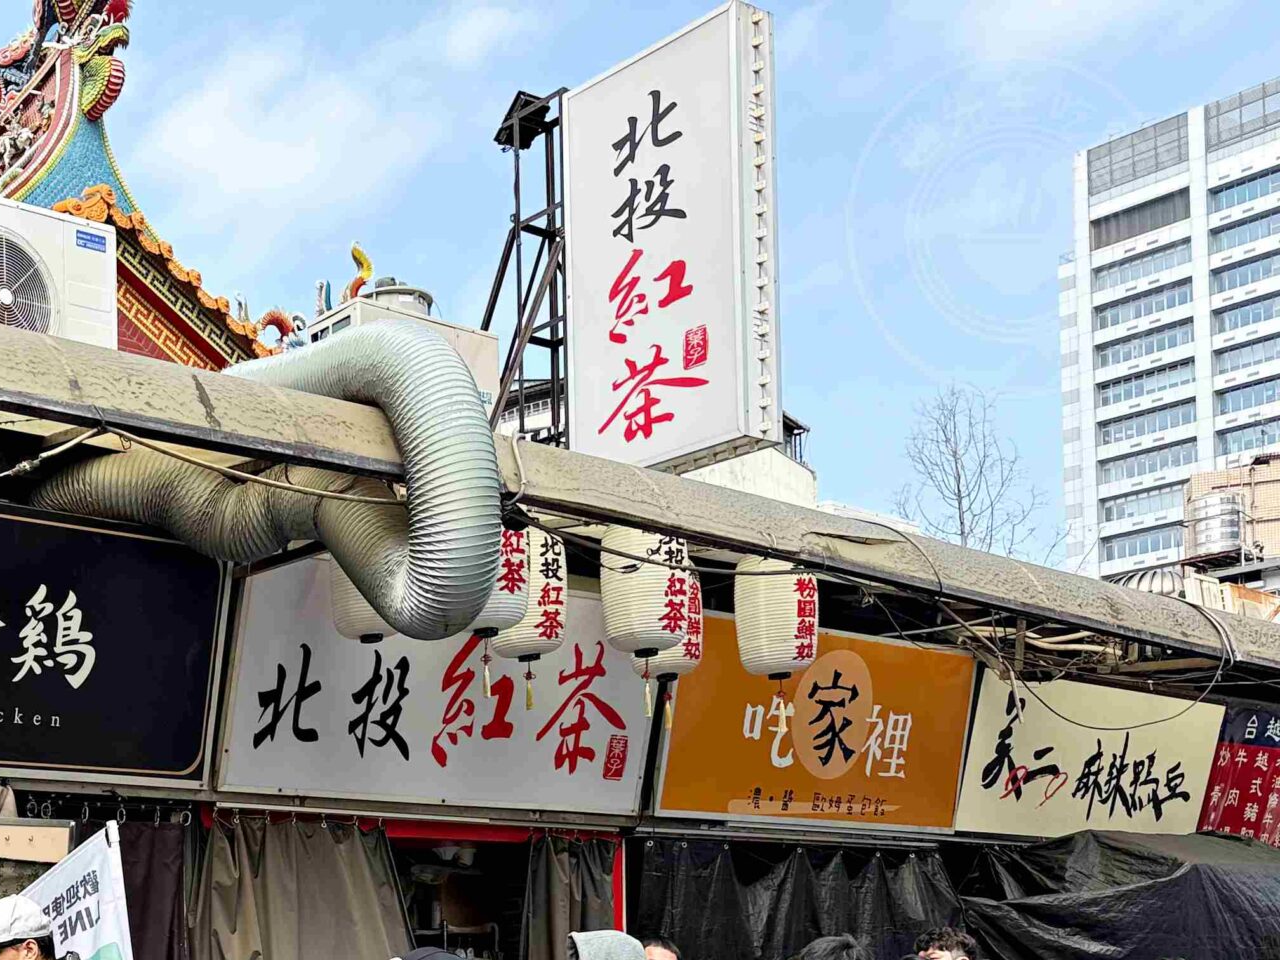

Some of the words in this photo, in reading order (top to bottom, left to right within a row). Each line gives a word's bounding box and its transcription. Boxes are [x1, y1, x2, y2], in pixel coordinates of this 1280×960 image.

[598, 90, 709, 443] 北投紅茶
[535, 536, 564, 640] 北投紅茶
[253, 635, 627, 776] 北投紅茶
[743, 669, 912, 779] 吃家裡
